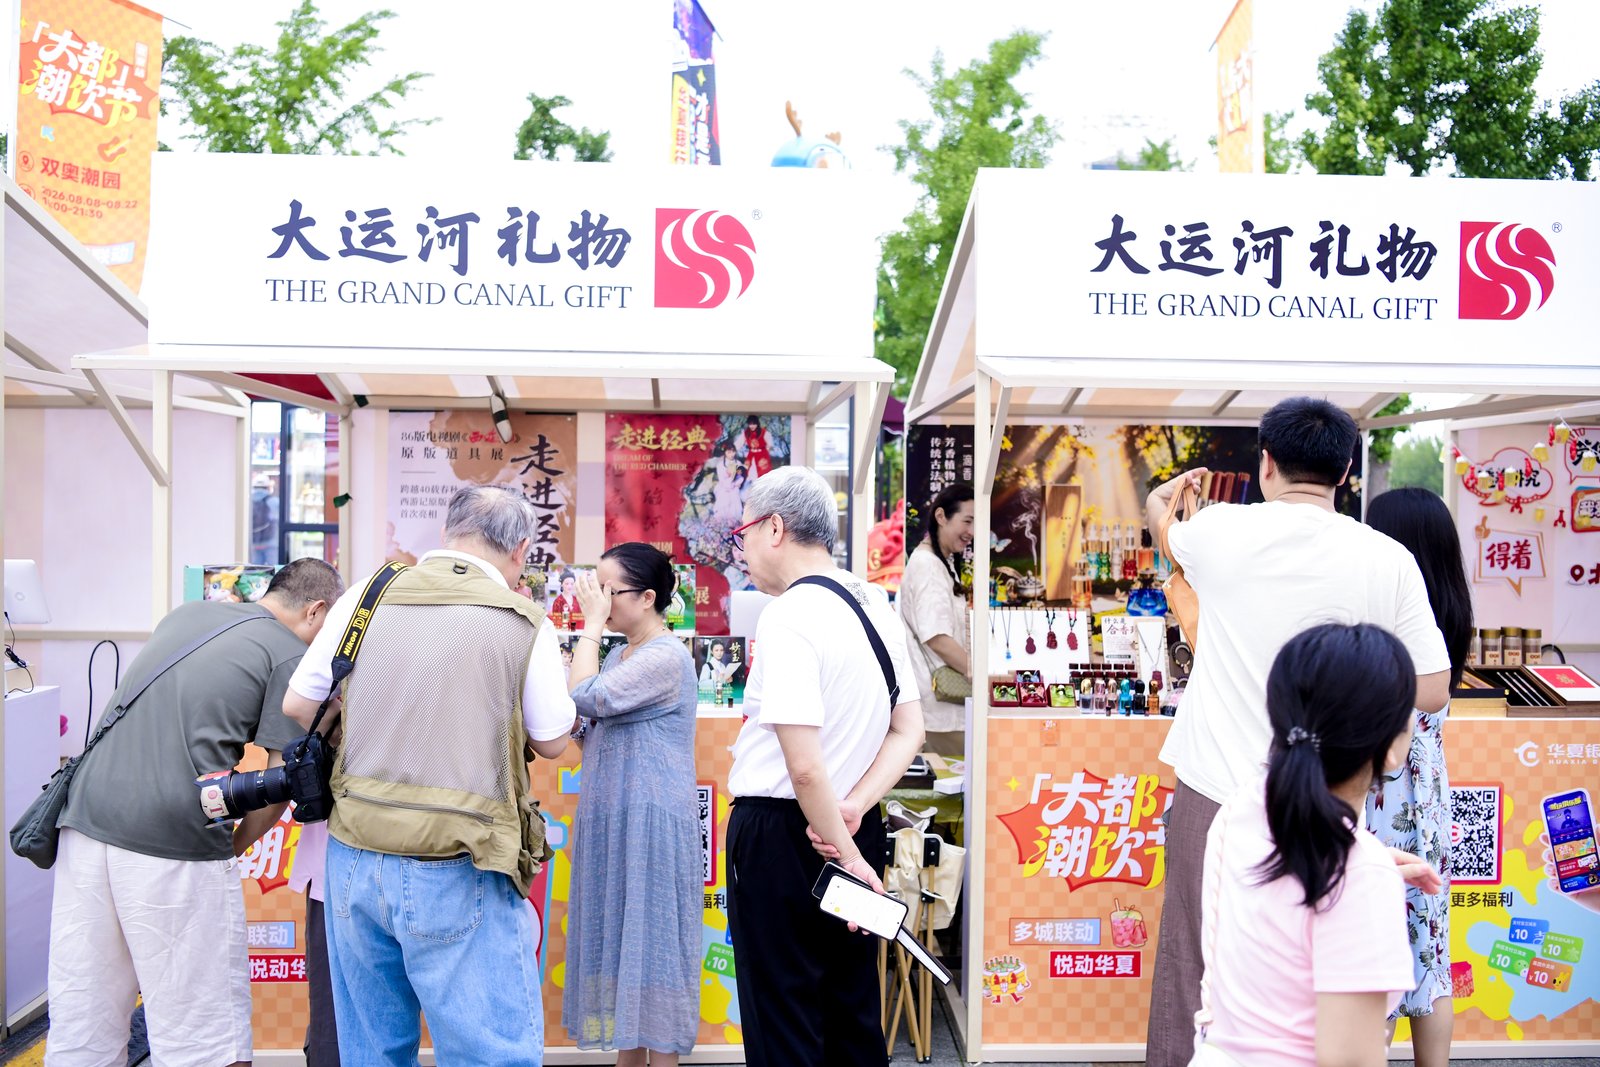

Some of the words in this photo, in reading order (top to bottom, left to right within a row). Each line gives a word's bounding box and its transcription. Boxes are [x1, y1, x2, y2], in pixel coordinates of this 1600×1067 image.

[20, 58, 142, 128] 潮饮节
[40, 157, 121, 190] 双奥潮园
[267, 199, 631, 276] 大运河礼物
[1090, 214, 1438, 289] 大运河礼物
[265, 279, 327, 302] THE
[338, 281, 446, 304] GRAND
[454, 283, 554, 307] CANAL
[564, 285, 633, 308] GIFT
[1089, 293, 1147, 315] THE
[1158, 294, 1260, 317] GRAND
[1268, 296, 1364, 319] CANAL
[1373, 298, 1438, 320] GIFT
[613, 423, 711, 451] 走进经典
[401, 447, 504, 461] 原版道具展
[1486, 540, 1532, 570] 得着
[343, 631, 358, 656] Nikon
[1451, 892, 1513, 907] 更多福利
[247, 925, 289, 945] 联动
[1014, 922, 1094, 942] 多城联动
[1054, 954, 1135, 974] 悦动华夏
